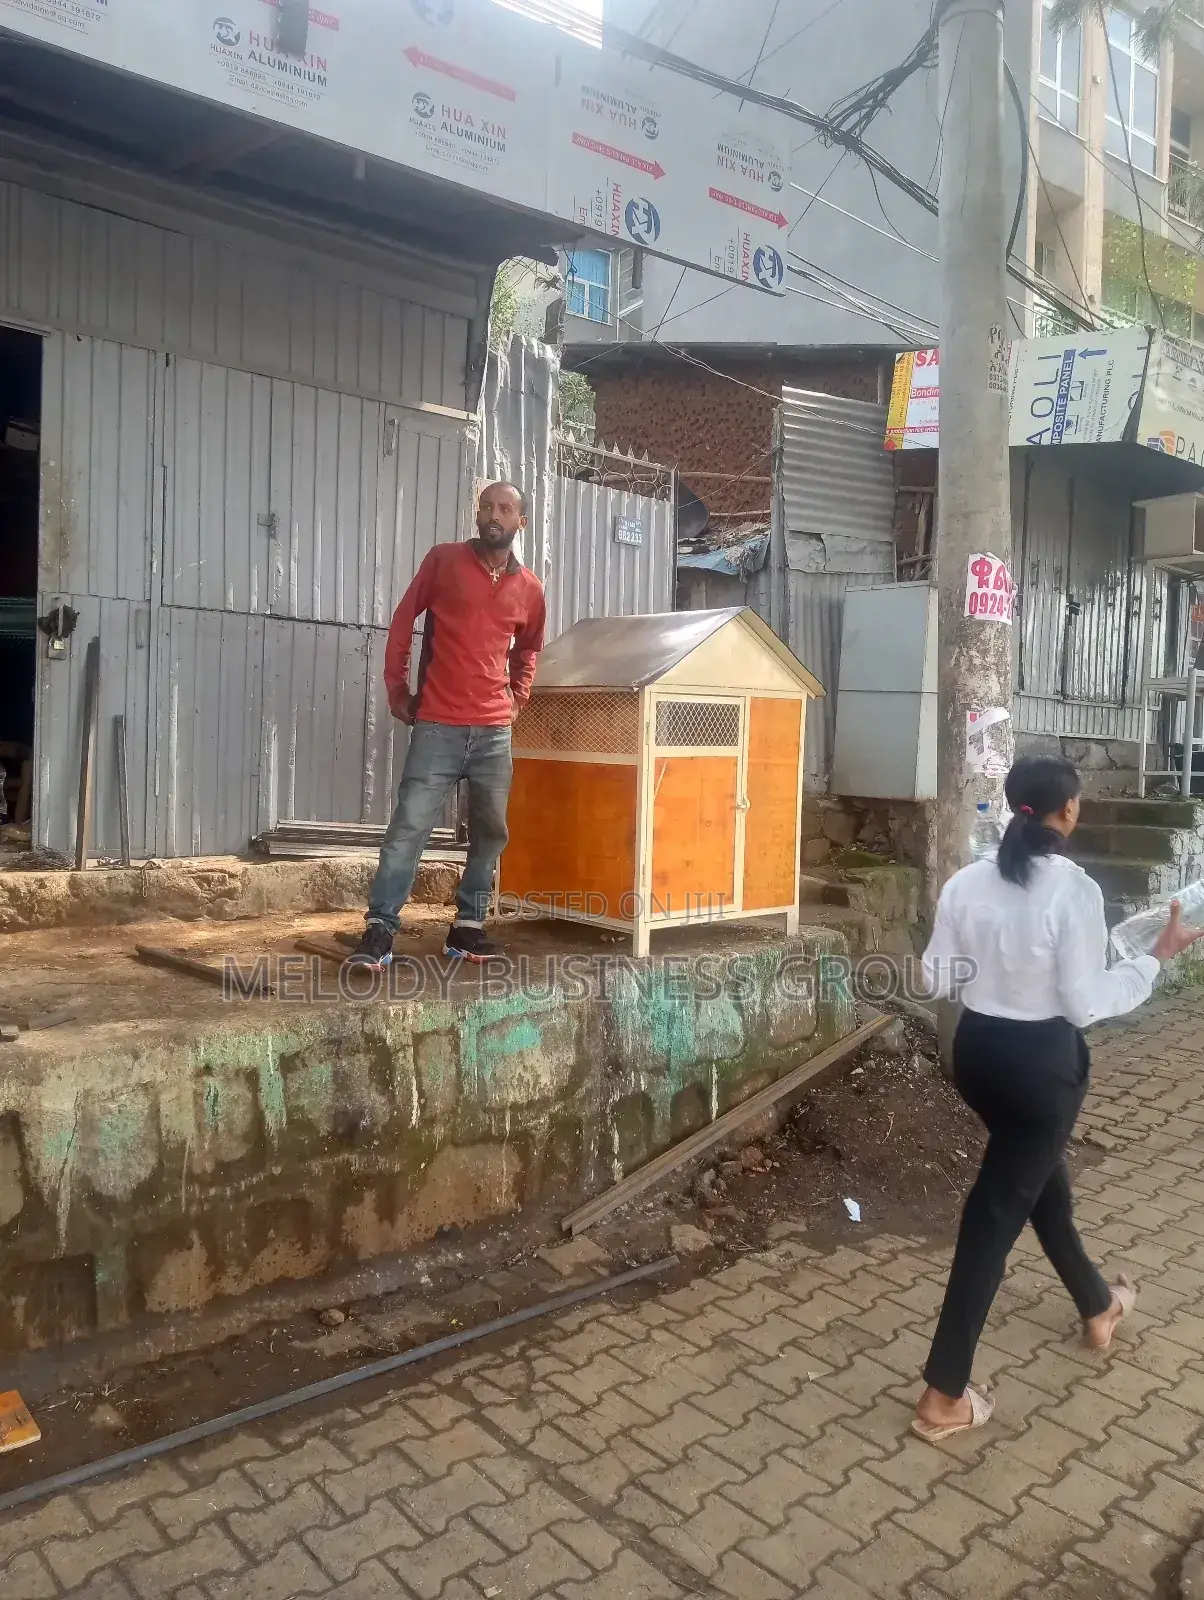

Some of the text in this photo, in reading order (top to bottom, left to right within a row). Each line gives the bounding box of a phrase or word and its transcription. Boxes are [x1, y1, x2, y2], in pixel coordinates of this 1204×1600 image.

[248, 49, 327, 87] ALUMINIUM
[581, 83, 637, 114] ALUMINIUM
[581, 98, 637, 130] HUA XIN
[441, 104, 506, 140] HUA XIN
[441, 121, 506, 153] ALUMINIUM
[716, 155, 764, 184] HUA XIN
[717, 142, 765, 169] ALUMINIUM
[1058, 355, 1074, 394] PANEL
[1107, 359, 1115, 376] PLC
[1025, 354, 1062, 445] AOLI
[1175, 436, 1204, 467] PA
